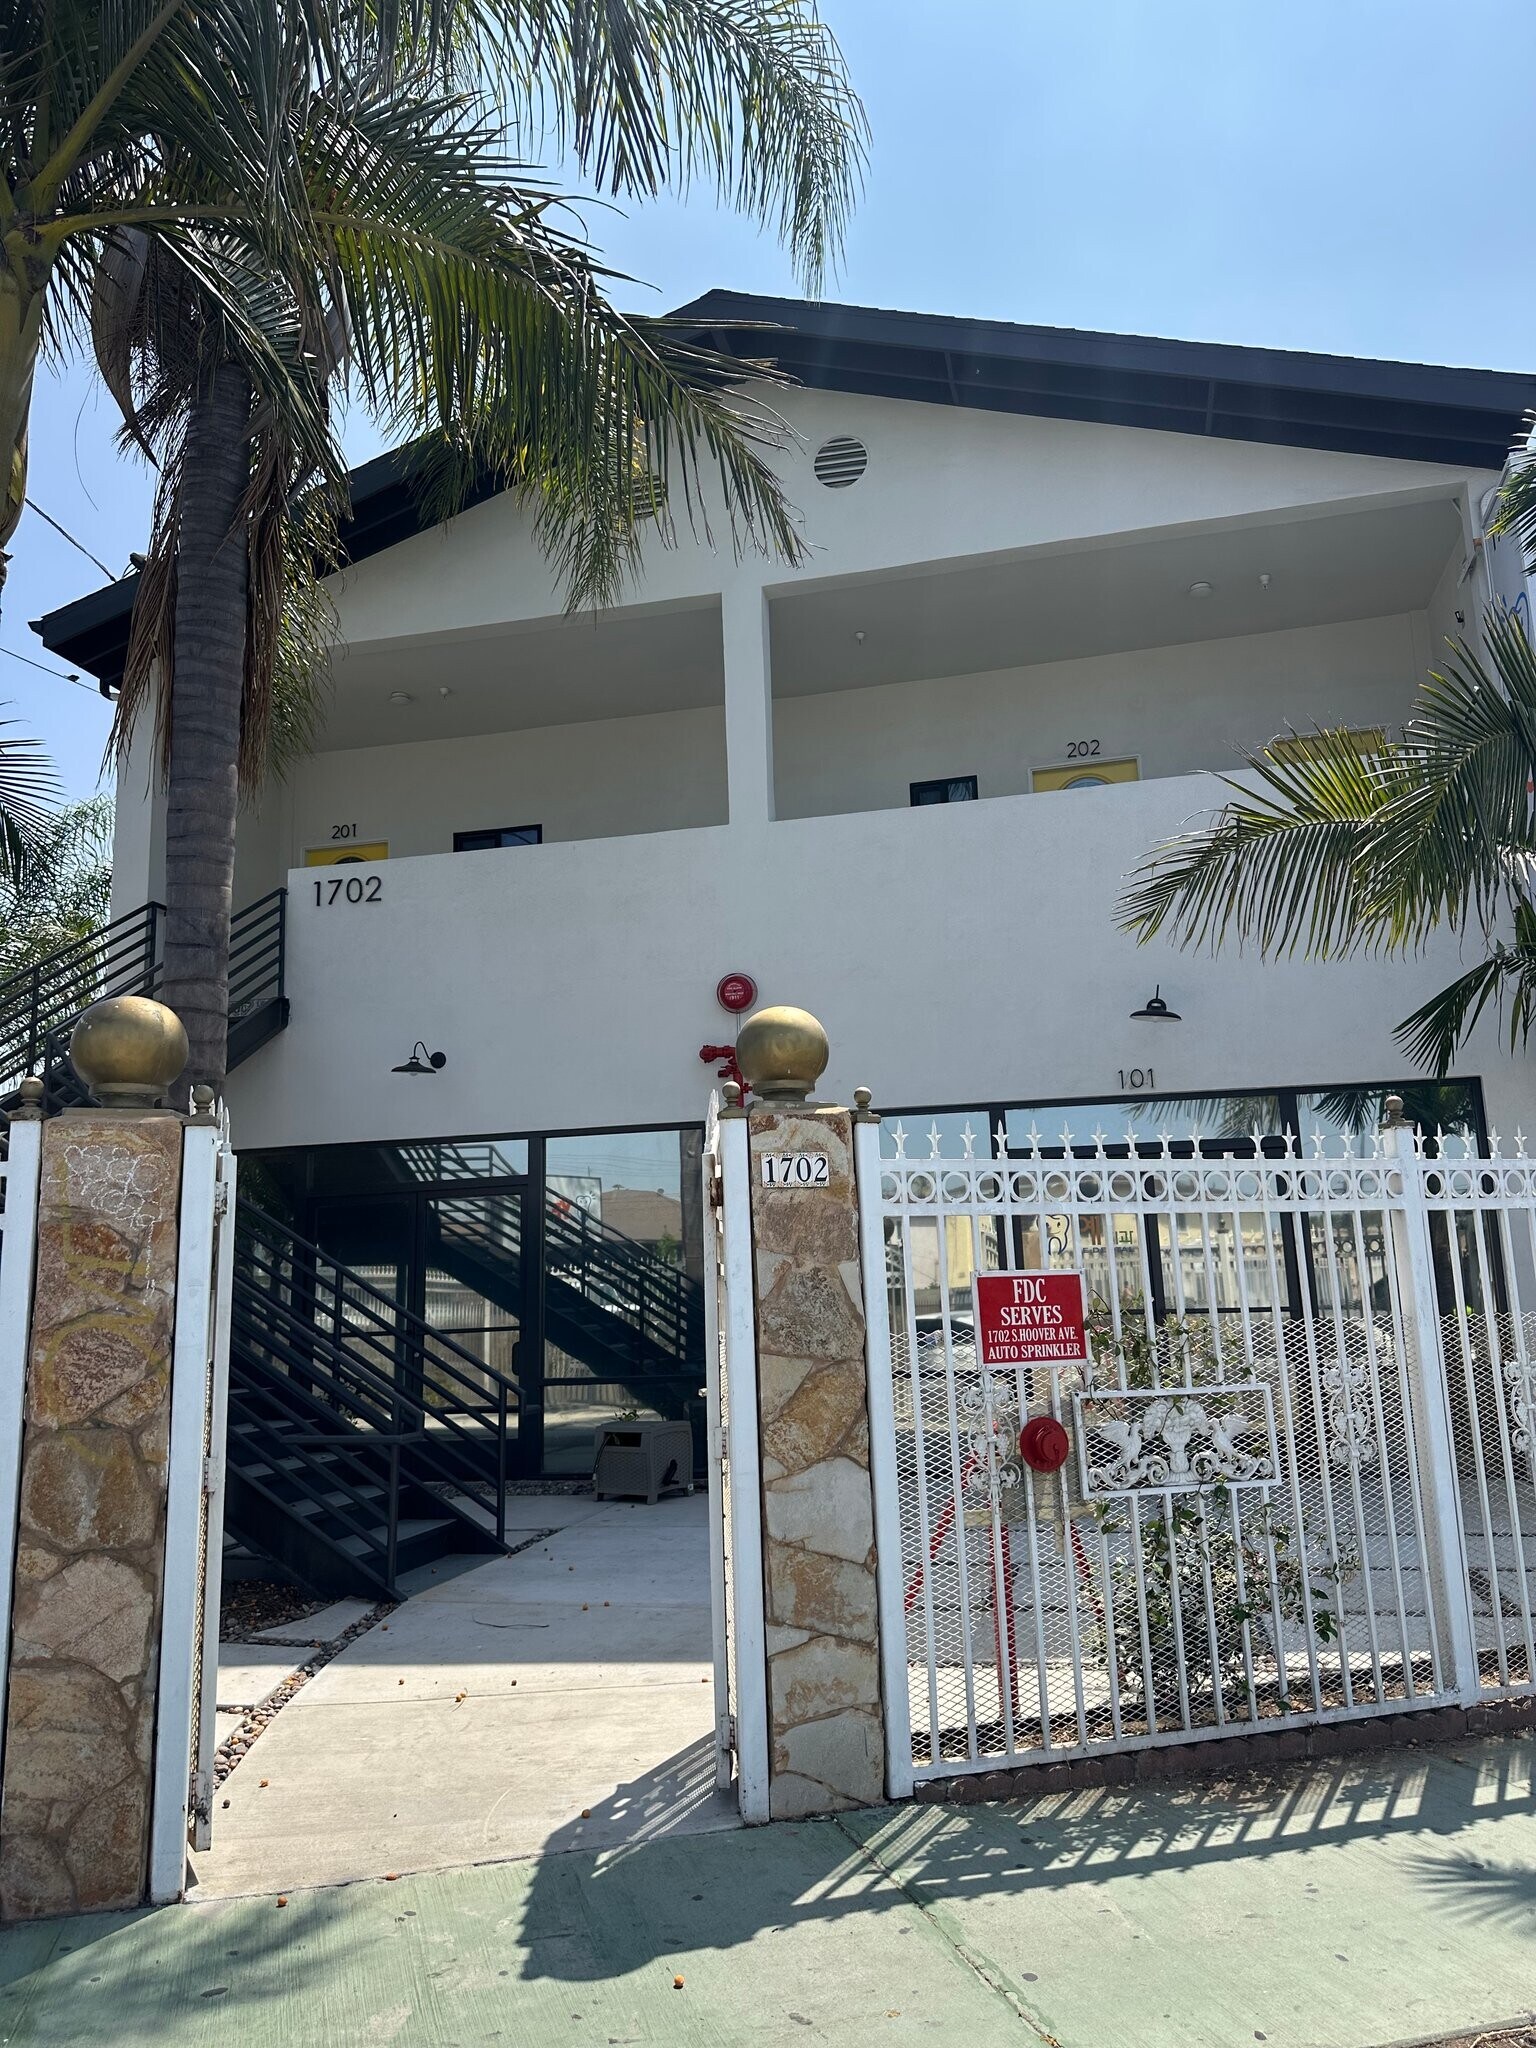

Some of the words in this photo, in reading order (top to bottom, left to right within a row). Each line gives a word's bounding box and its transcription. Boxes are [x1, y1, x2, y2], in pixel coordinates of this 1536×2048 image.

[1067, 739, 1101, 758] 202
[331, 823, 357, 839] 201
[313, 875, 382, 907] 1702
[1117, 1067, 1154, 1089] 101
[766, 1157, 828, 1183] 1702
[1012, 1278, 1047, 1304] FDC
[1000, 1305, 1063, 1326] SERVES
[987, 1330, 1011, 1344] 1702
[1058, 1326, 1079, 1341] AVE.
[988, 1345, 1019, 1360] AUTO
[1021, 1342, 1081, 1359] SPRINKLER
